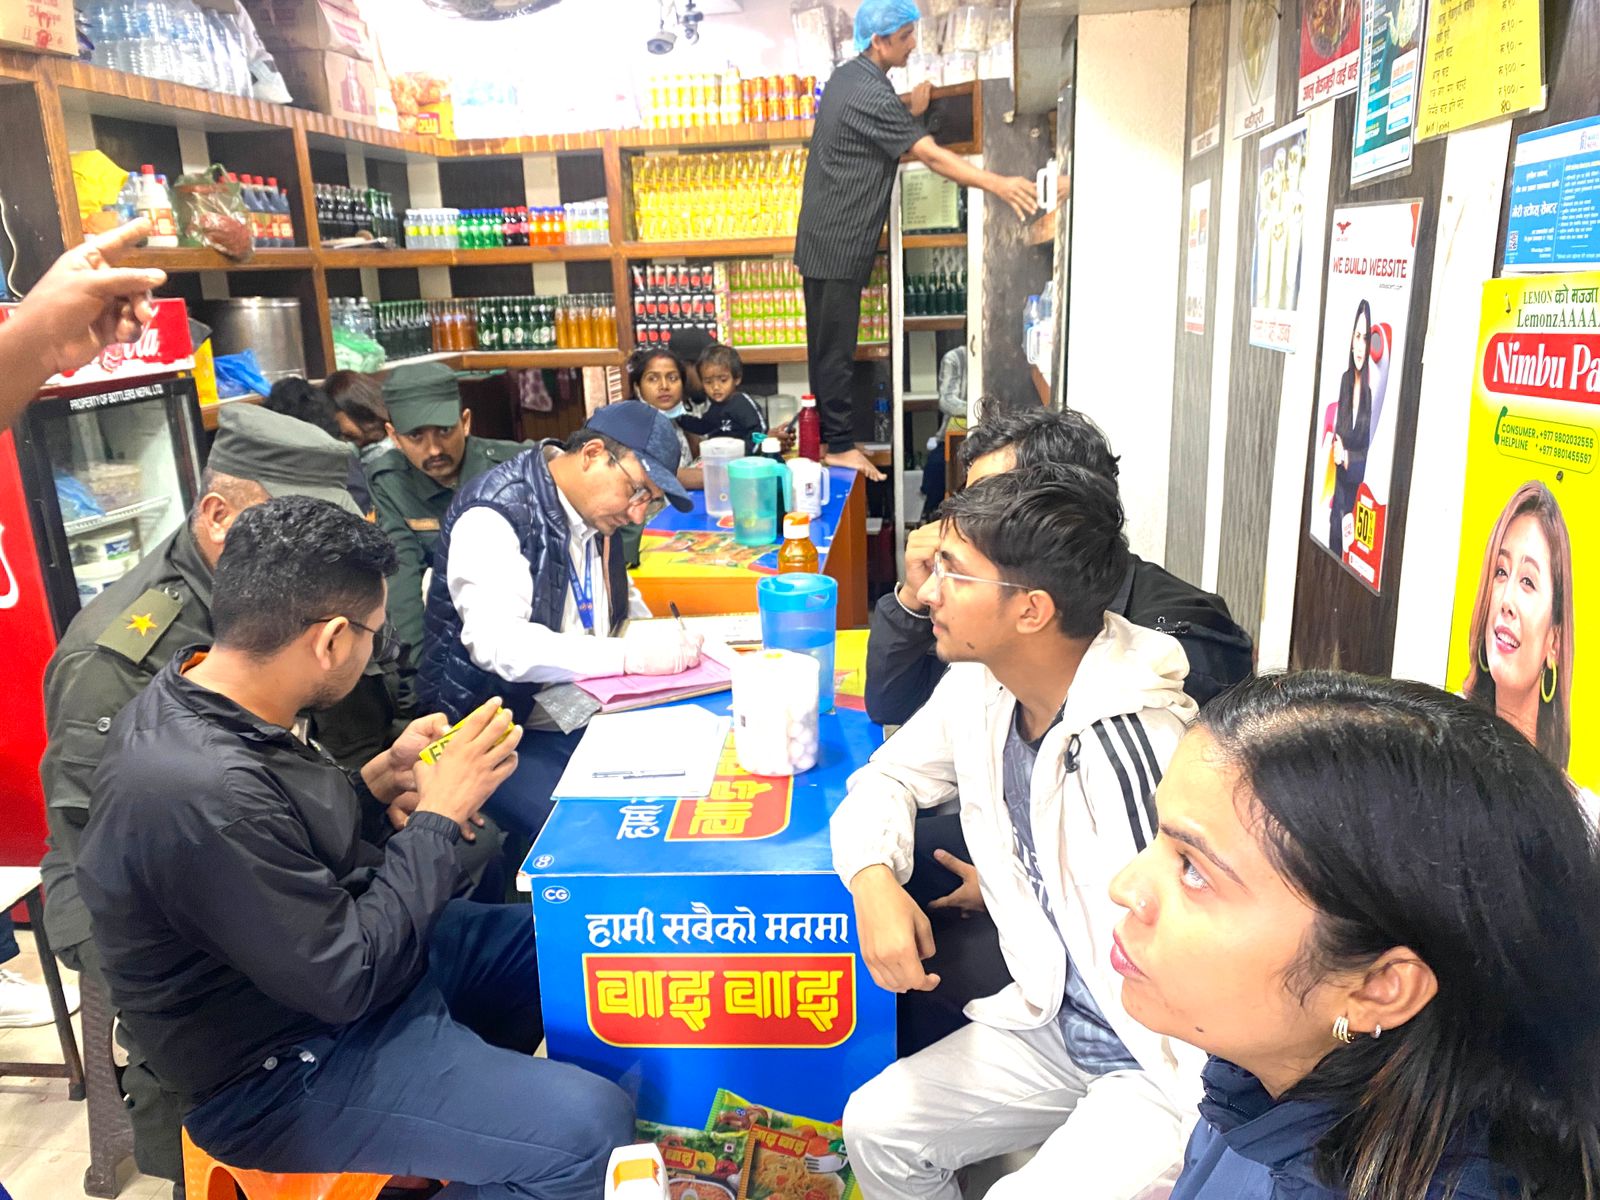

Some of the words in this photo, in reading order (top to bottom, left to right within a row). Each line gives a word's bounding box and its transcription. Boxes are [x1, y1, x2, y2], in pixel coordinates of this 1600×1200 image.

[1333, 257, 1343, 273] WE
[1344, 257, 1367, 275] BUILD
[1369, 258, 1407, 278] WEBSITE
[1523, 290, 1553, 305] LEMON
[1555, 284, 1569, 304] को
[1517, 307, 1600, 328] LemonzAAAA
[1493, 341, 1566, 389] Nimbu
[70, 394, 100, 411] PROPERTY
[108, 389, 135, 404] BOTTLERS
[136, 386, 152, 398] NEPAL
[1501, 424, 1536, 438] CONSUMER
[1540, 430, 1553, 441] +977
[1501, 436, 1528, 451] HELPLINE
[1539, 446, 1553, 456] +977
[1357, 506, 1369, 541] 50
[535, 855, 553, 869] CG
[545, 888, 568, 901] CG
[585, 907, 655, 948] हामी
[660, 902, 756, 945] सबैको
[763, 913, 849, 945] मनमा
[595, 970, 715, 1032] वाइ
[724, 970, 844, 1032] वाइ
